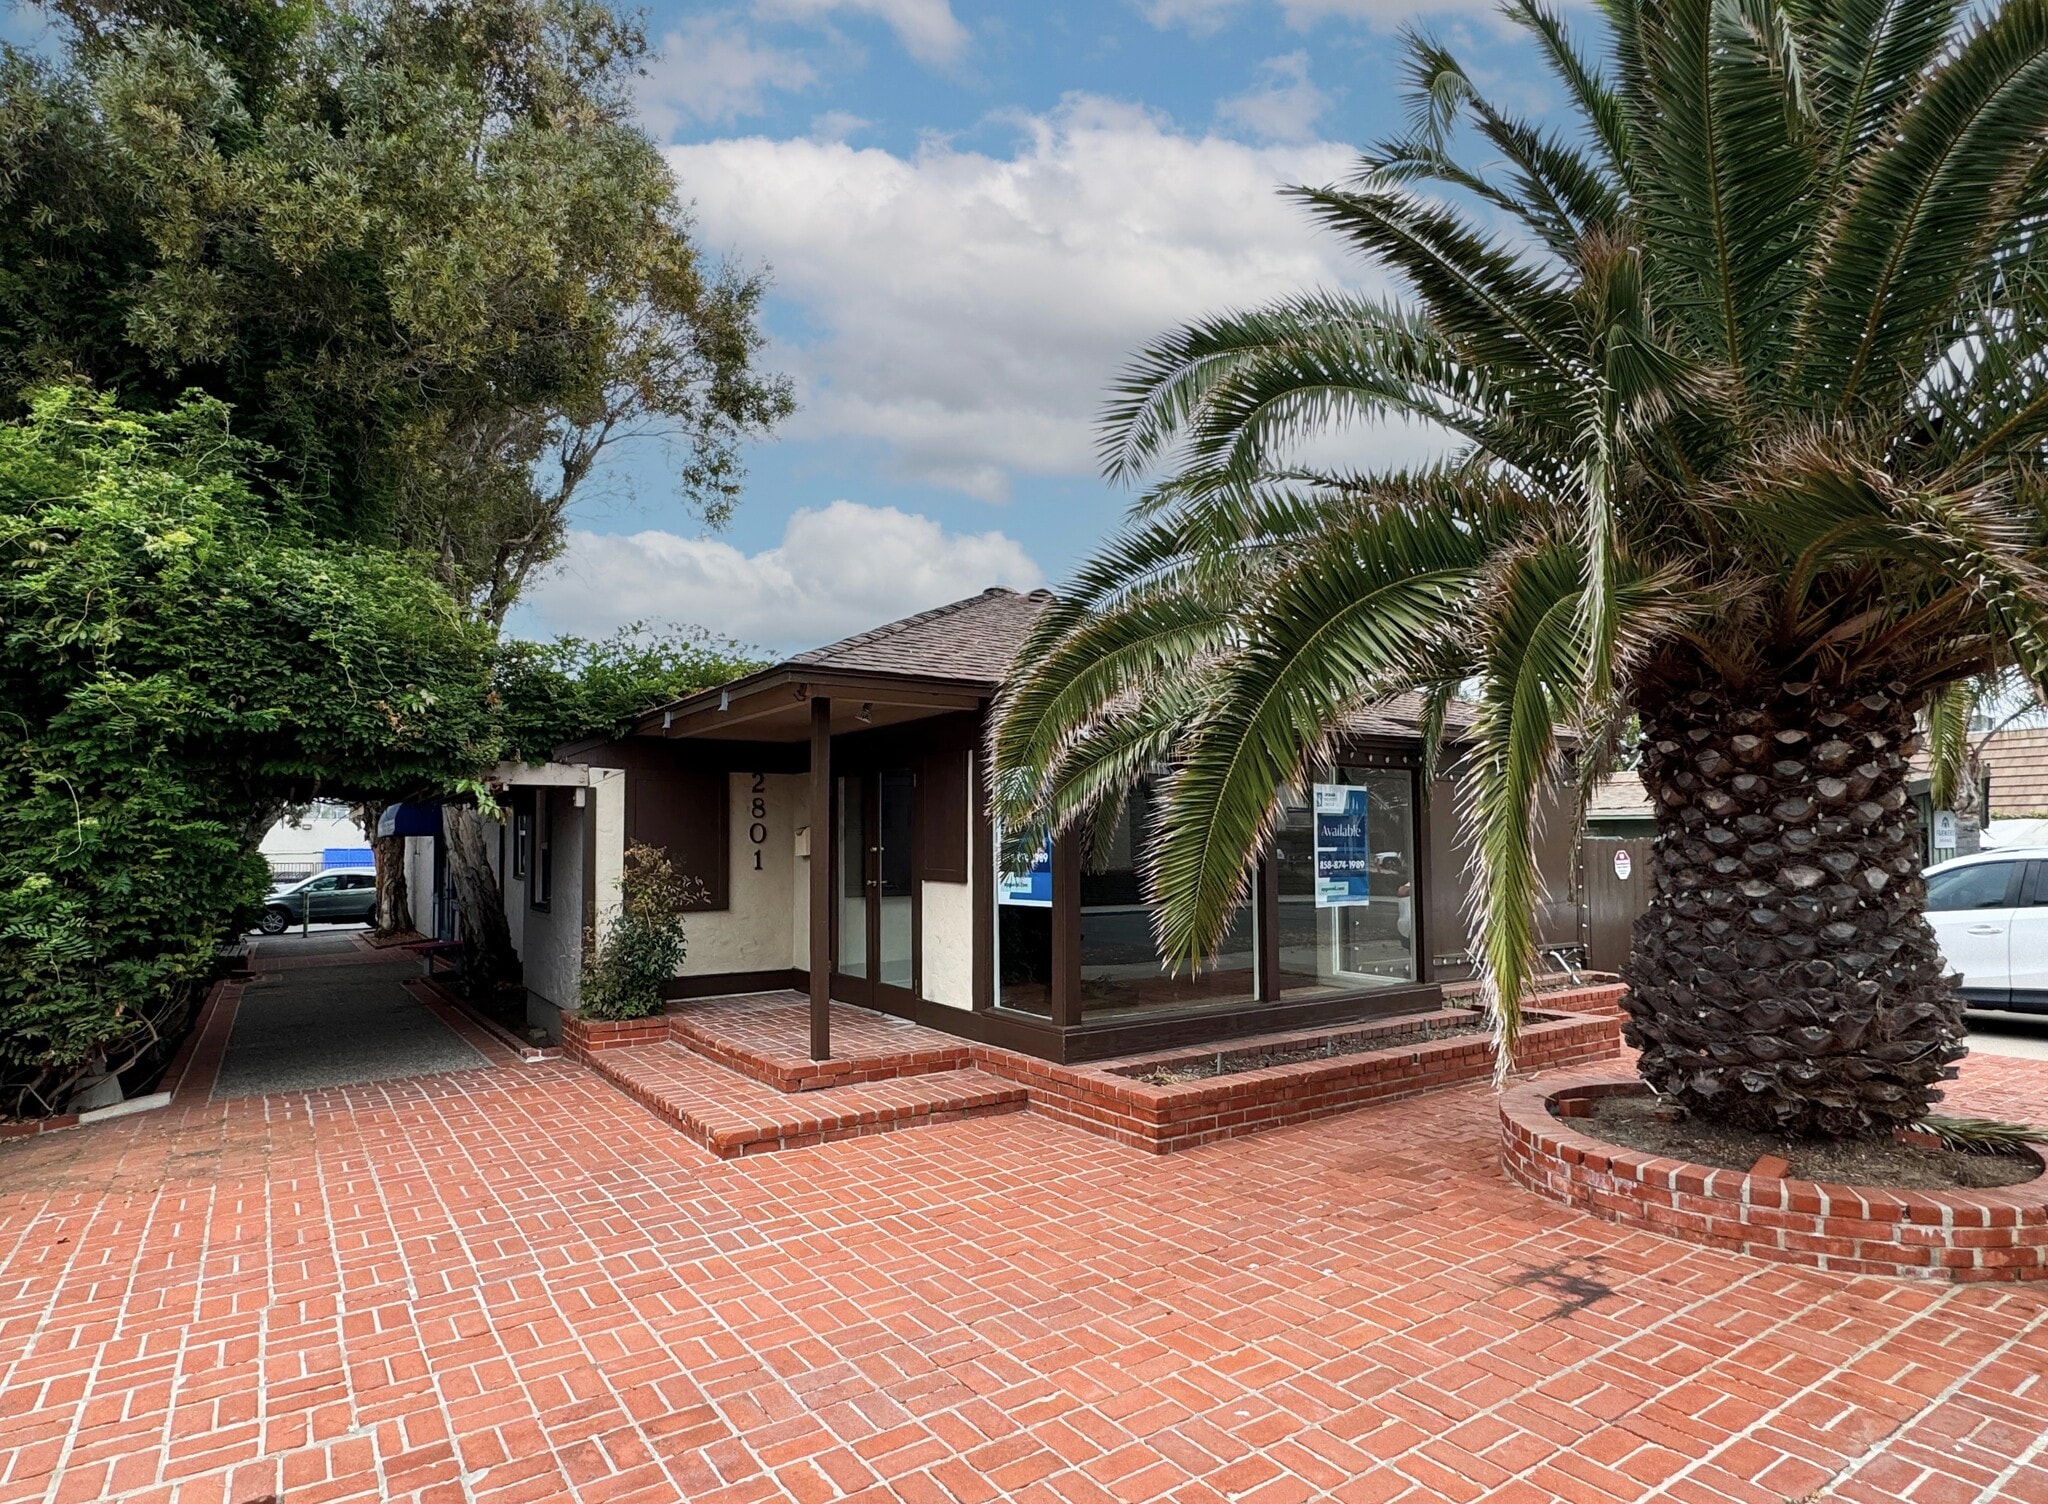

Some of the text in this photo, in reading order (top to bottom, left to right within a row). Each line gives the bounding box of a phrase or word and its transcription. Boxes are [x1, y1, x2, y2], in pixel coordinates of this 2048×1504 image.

[749, 772, 767, 870] 2801
[1321, 823, 1361, 837] Available
[1319, 860, 1365, 869] 858-874-1989
